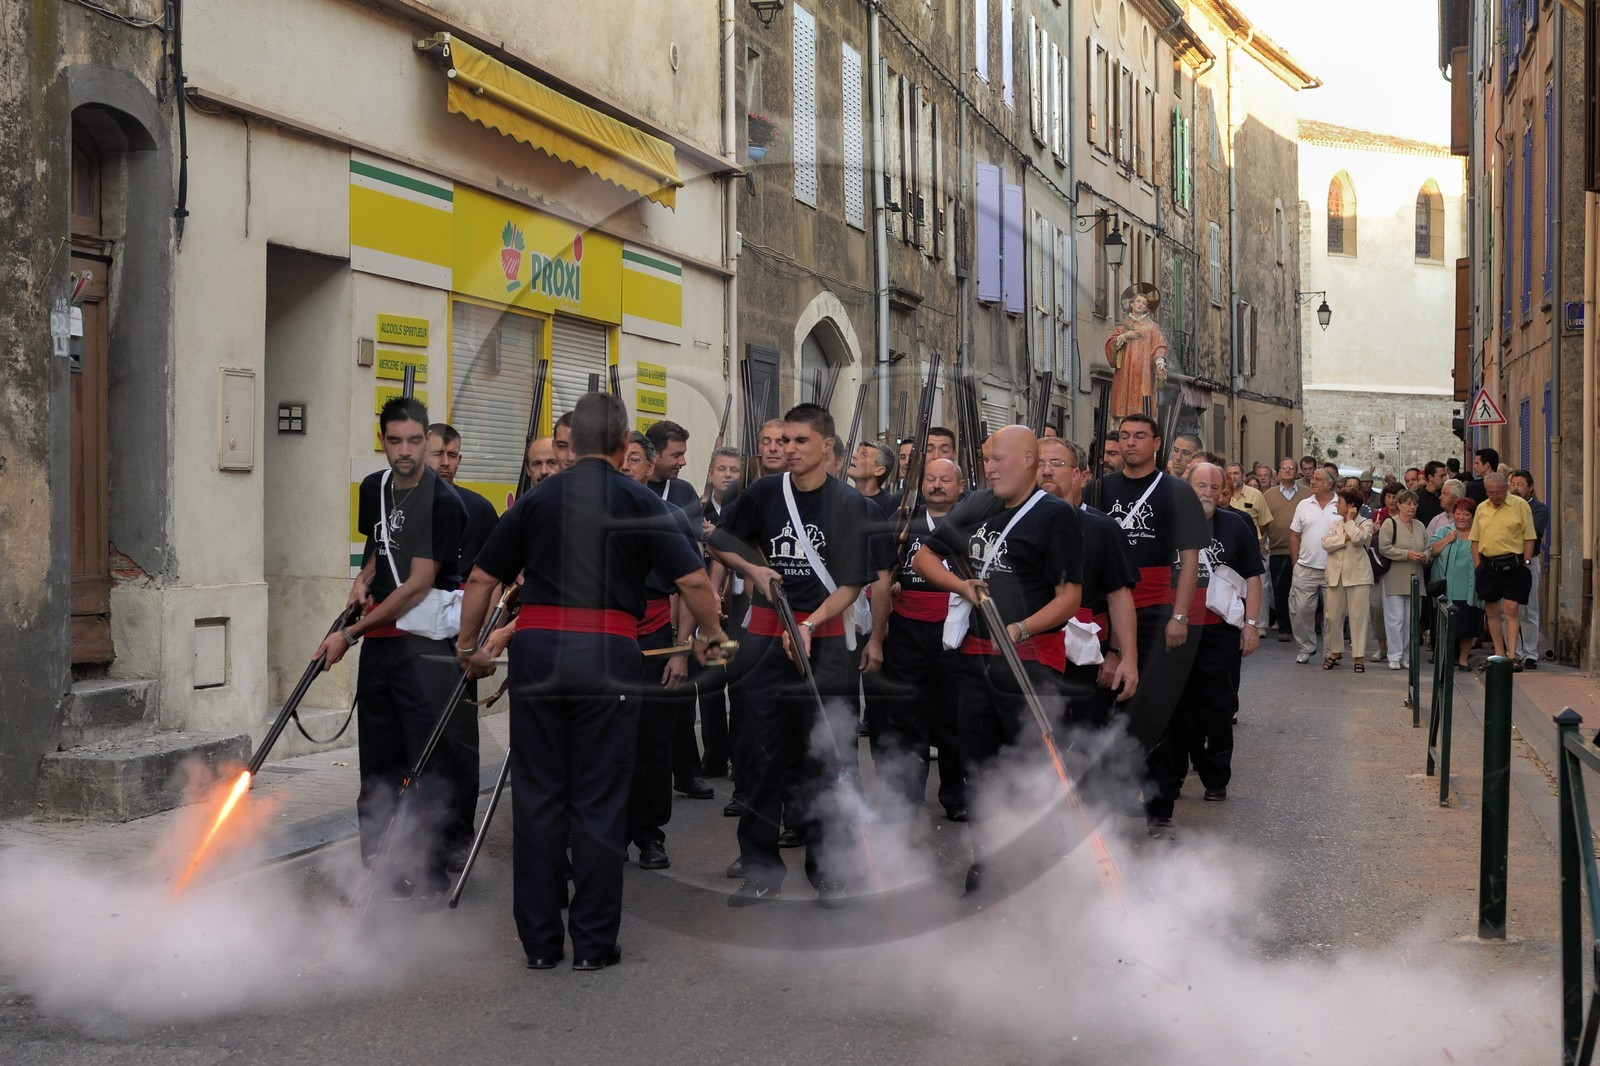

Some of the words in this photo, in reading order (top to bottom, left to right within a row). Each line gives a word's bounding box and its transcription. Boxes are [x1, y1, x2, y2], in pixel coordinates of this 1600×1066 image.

[380, 323, 402, 335] ALCOOLS
[403, 325, 427, 338] SPIRITUEUX
[379, 359, 399, 371] MERCERIE
[784, 568, 811, 576] BRAS
